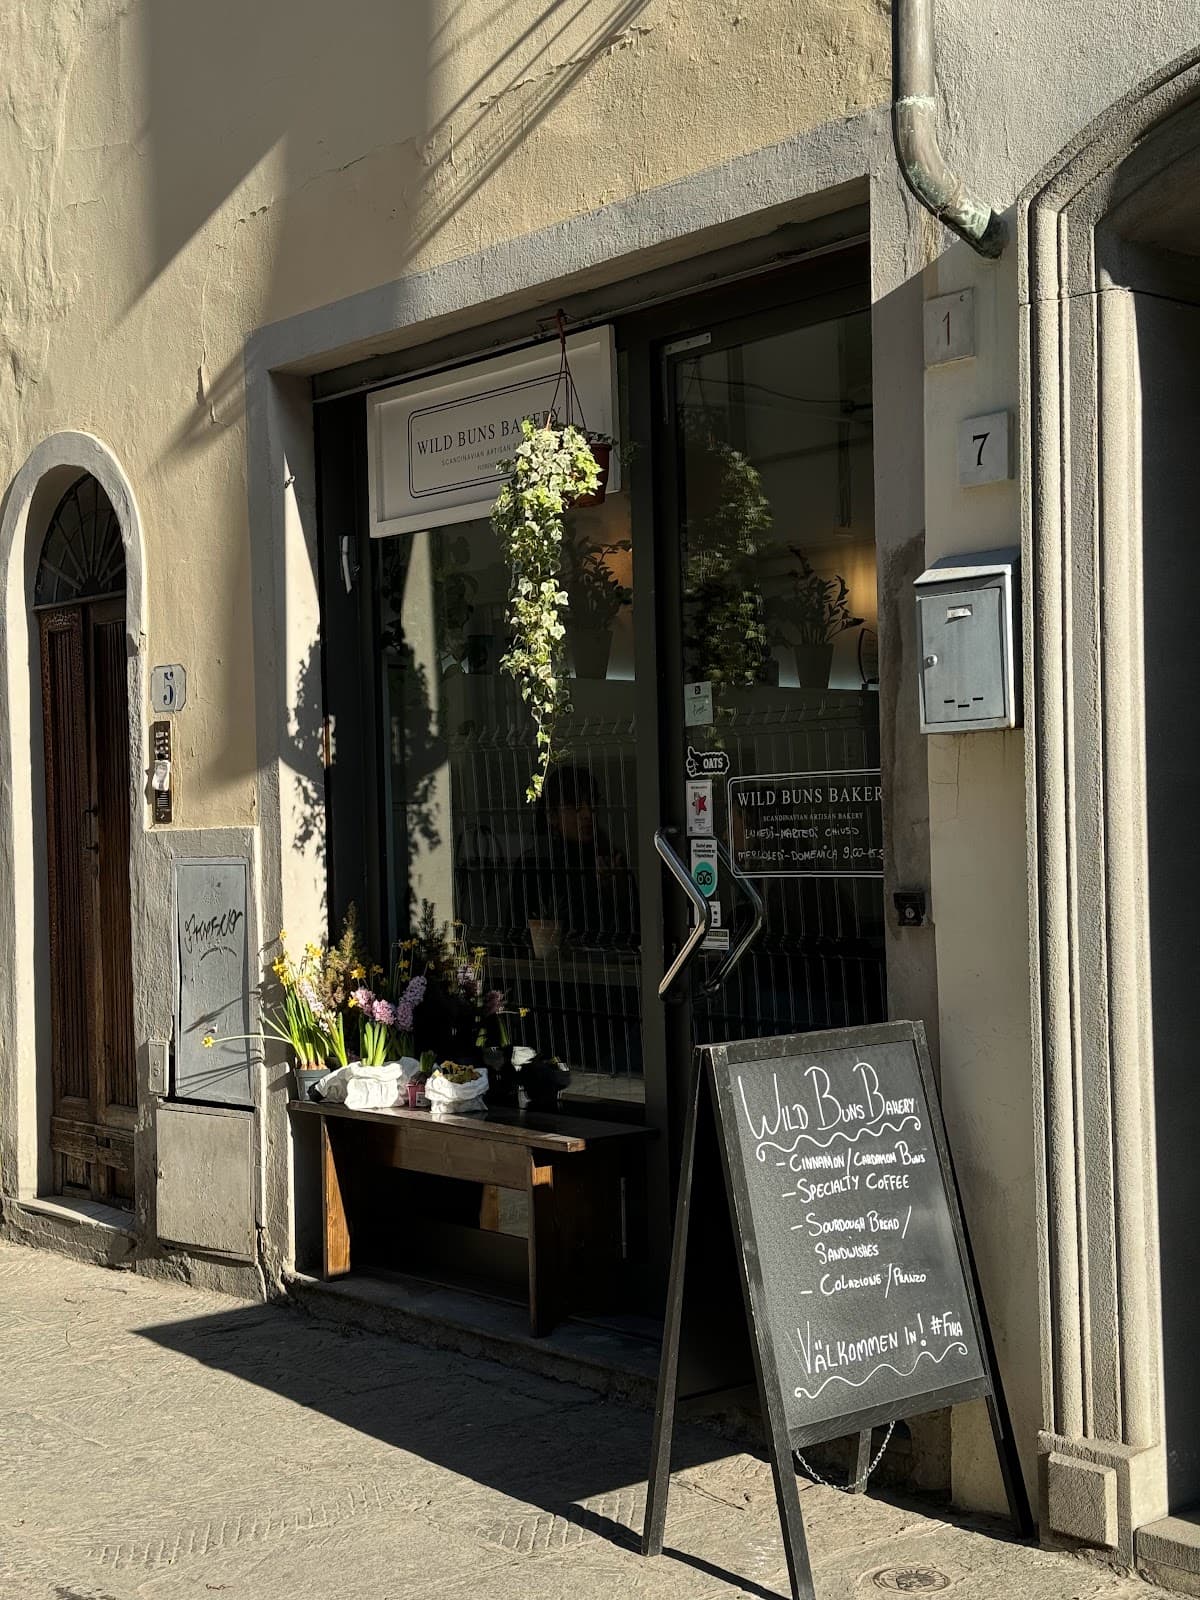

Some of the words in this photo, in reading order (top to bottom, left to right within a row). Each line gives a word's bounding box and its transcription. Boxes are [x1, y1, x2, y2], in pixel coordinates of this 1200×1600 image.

[942, 311, 950, 346] 1
[416, 434, 453, 455] WILD
[457, 423, 495, 447] BUNS
[971, 431, 991, 466] 7
[440, 450, 485, 466] SCANDINAVIAN
[486, 444, 511, 457] ARTISAN
[162, 671, 175, 706] 5
[703, 757, 724, 769] OATS
[736, 791, 776, 808] WILD
[781, 788, 823, 806] BUNS
[829, 786, 883, 803] BAKER
[763, 814, 808, 822] SCANDINAVIAN
[810, 813, 837, 821] ARTISAN
[838, 812, 864, 820] BAKERY
